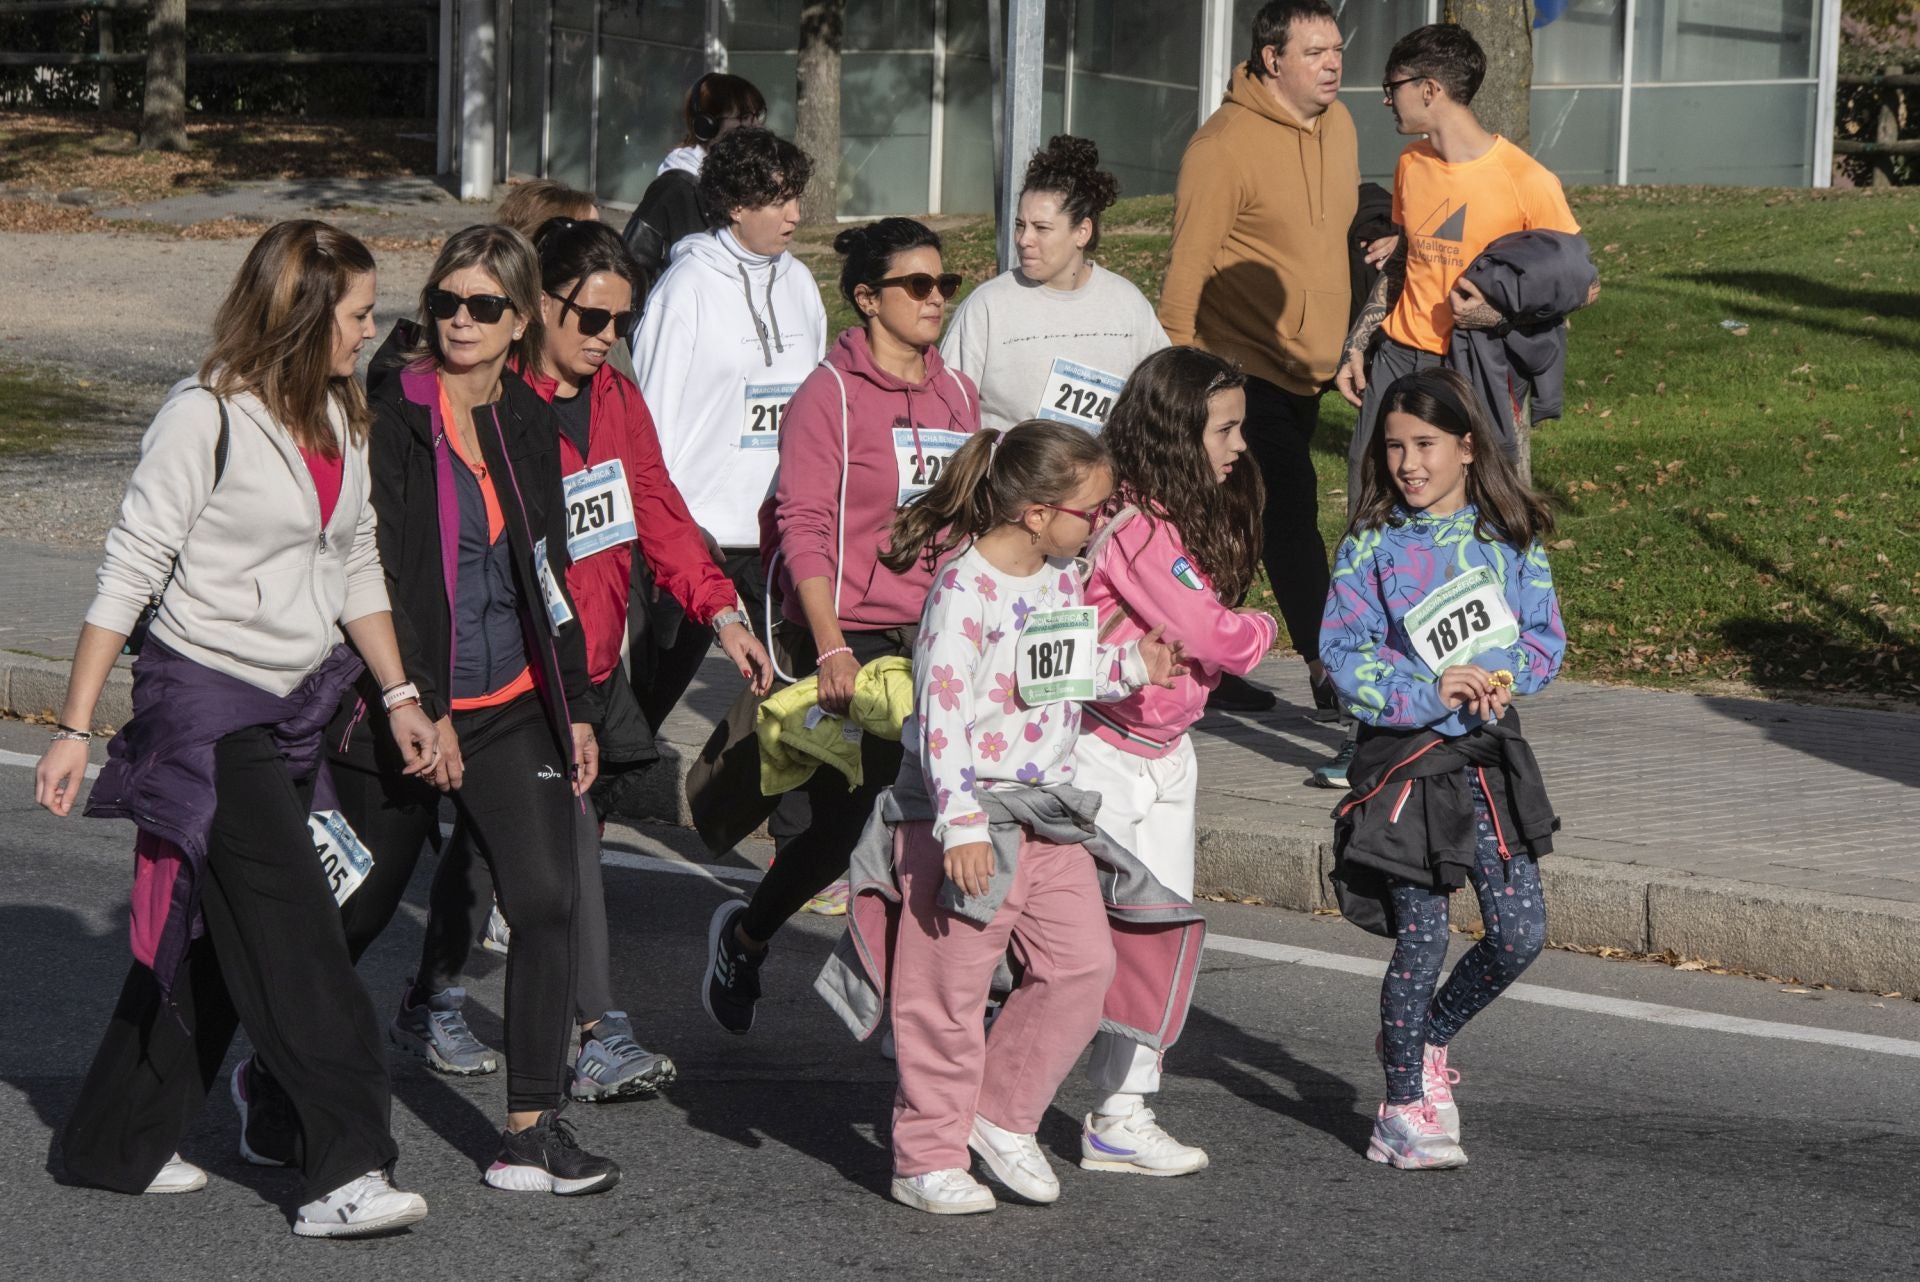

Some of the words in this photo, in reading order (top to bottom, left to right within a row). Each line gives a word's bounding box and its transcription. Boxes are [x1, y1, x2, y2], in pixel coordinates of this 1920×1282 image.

[1416, 238, 1460, 255] Mallorca
[1054, 383, 1112, 423] 2124
[910, 454, 952, 485] 22
[1174, 561, 1190, 575] ITAL
[1426, 599, 1491, 660] 1873
[1027, 638, 1075, 680] 1827
[537, 768, 561, 779] spyro
